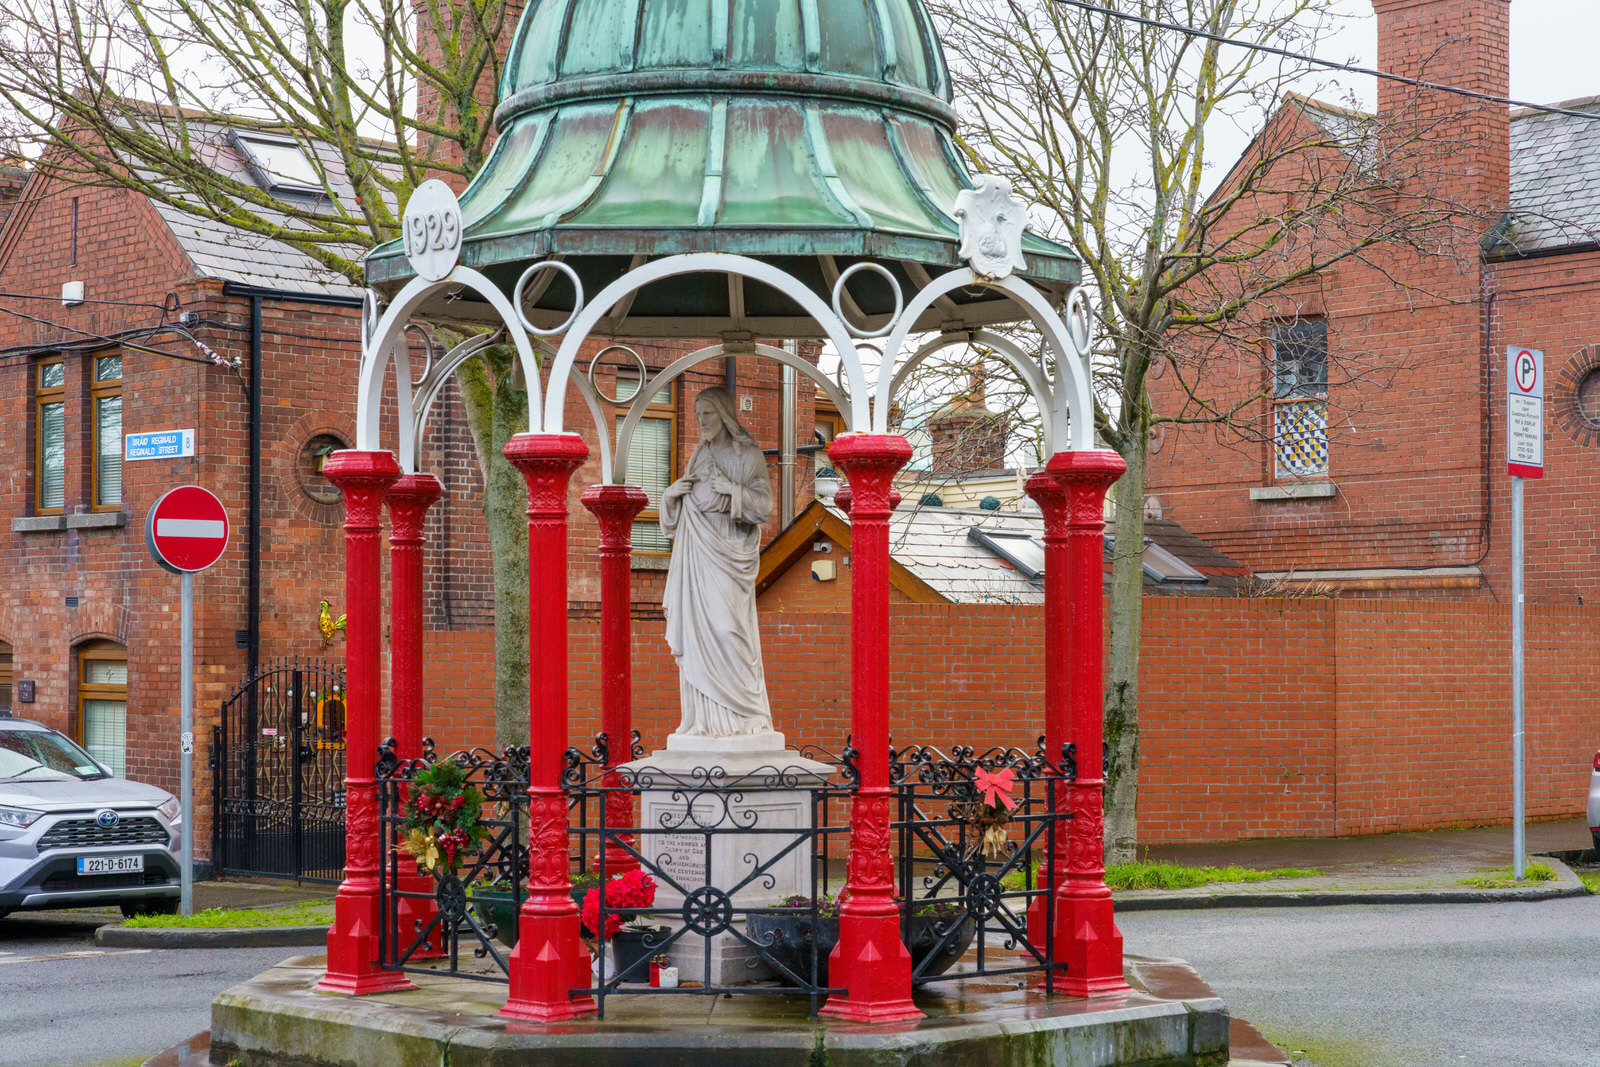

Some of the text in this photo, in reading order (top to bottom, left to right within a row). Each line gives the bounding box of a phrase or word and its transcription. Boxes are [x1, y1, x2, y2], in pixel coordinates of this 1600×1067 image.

[402, 208, 460, 257] 1929
[132, 435, 190, 448] SRÁID REGINALD 8
[130, 446, 178, 456] REGINALD STREET
[88, 858, 138, 871] 221-D-6174
